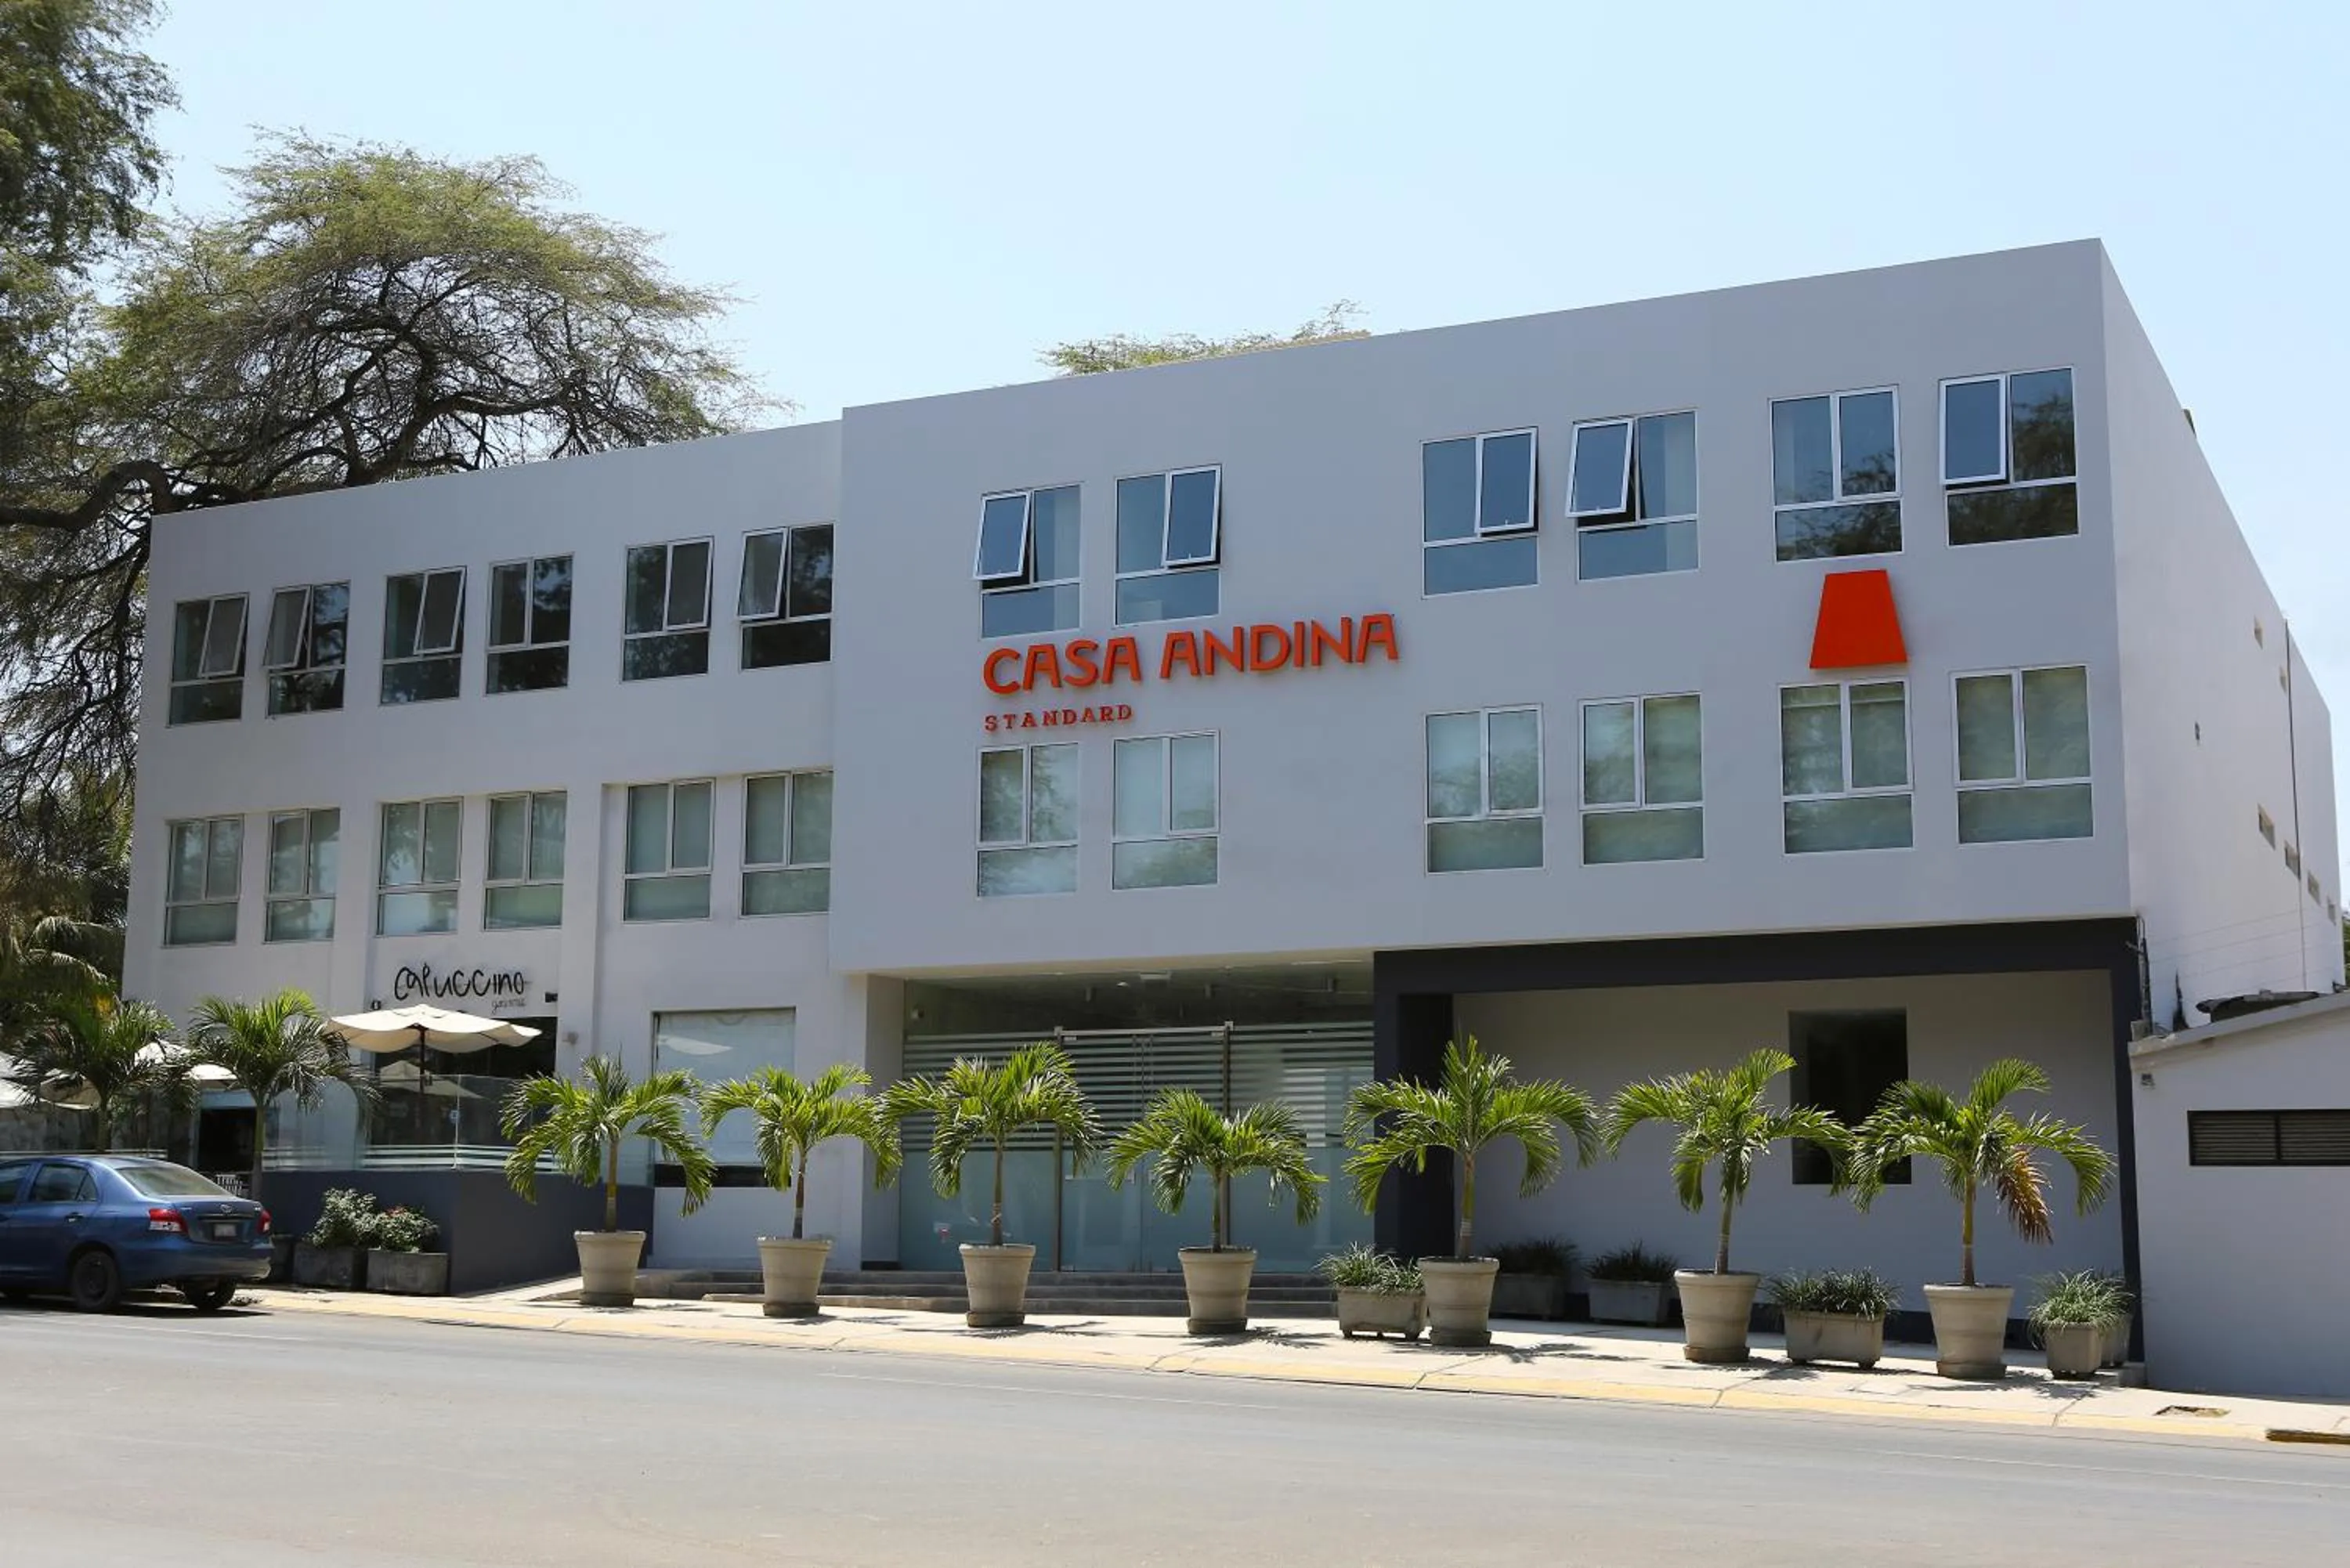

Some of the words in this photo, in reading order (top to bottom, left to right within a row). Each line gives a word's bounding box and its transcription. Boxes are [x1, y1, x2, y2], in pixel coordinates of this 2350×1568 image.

[983, 636, 1142, 695] CASA
[1160, 612, 1399, 678] ANDINA
[985, 704, 1133, 732] STANDARD
